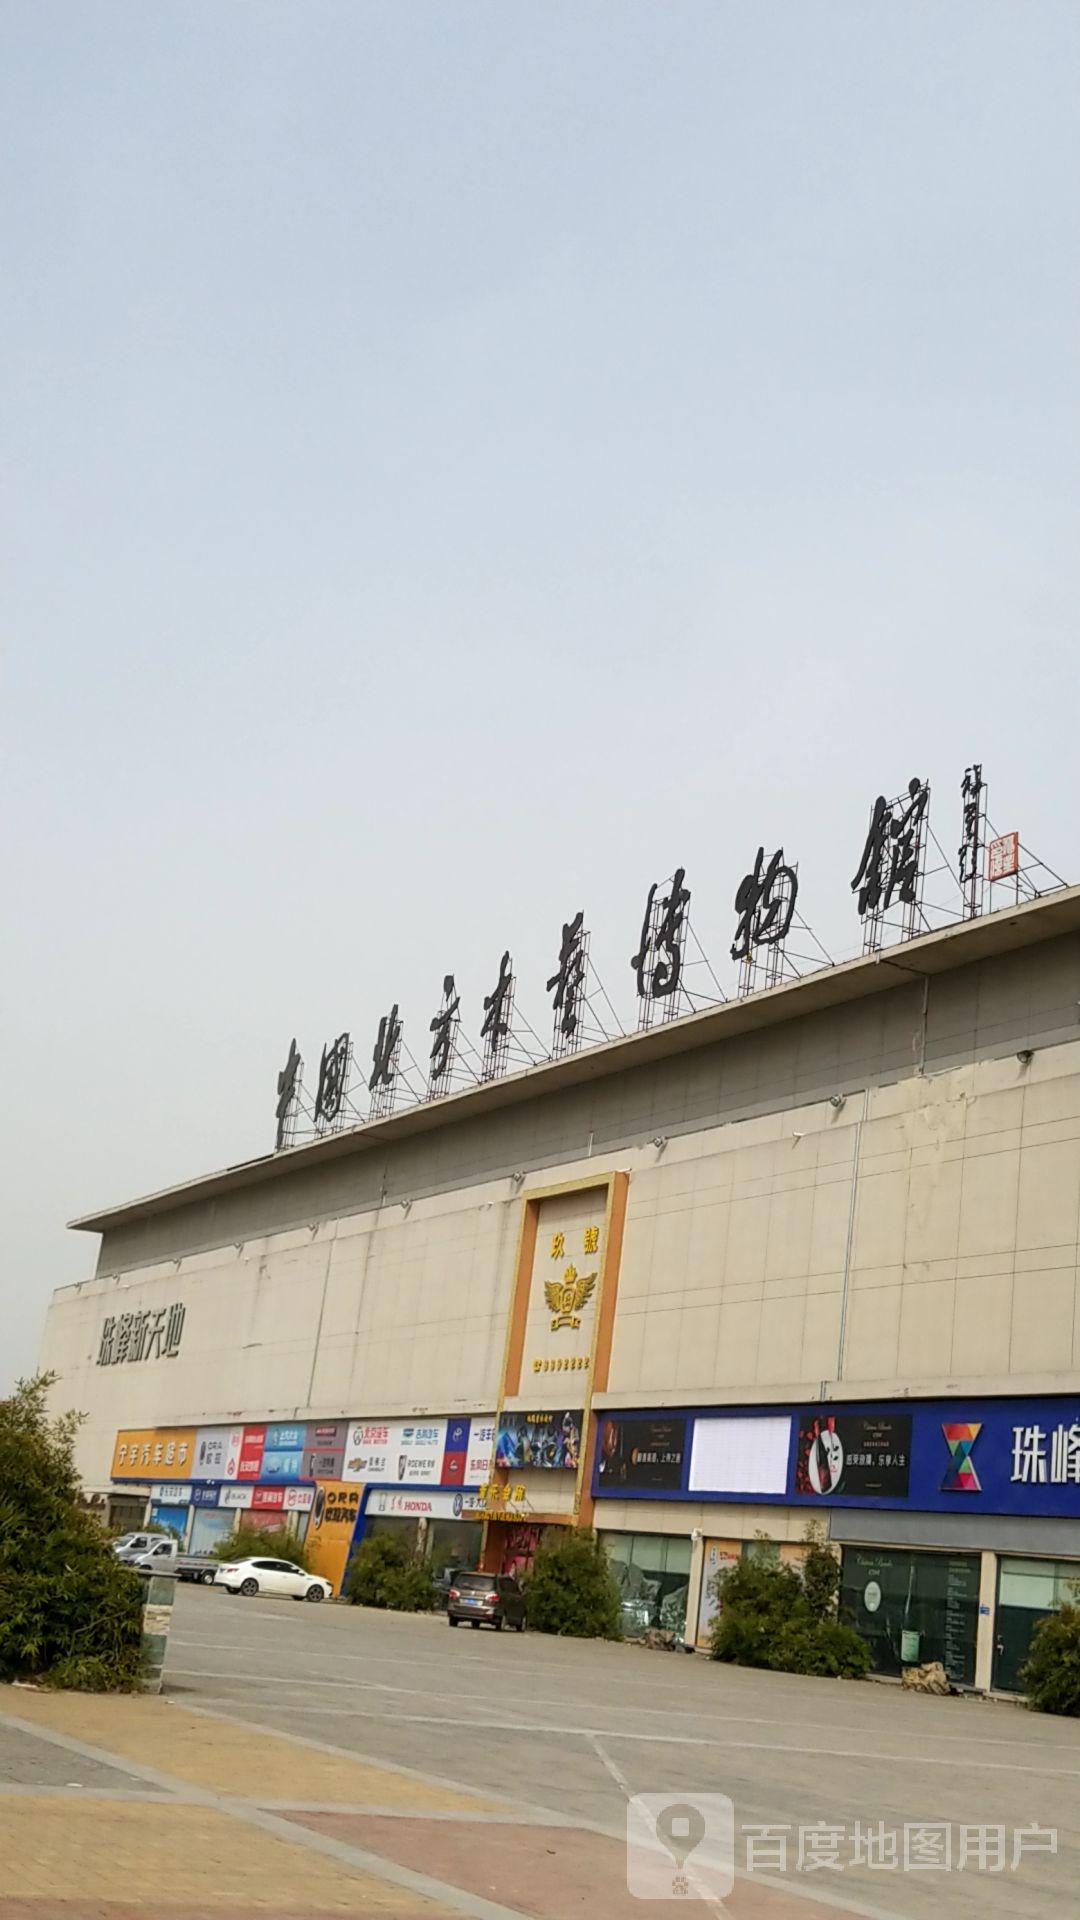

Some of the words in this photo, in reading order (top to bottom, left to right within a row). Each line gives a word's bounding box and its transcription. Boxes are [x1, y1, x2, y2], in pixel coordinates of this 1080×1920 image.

[327, 1492, 359, 1504] ORA
[404, 1501, 432, 1512] HONDA
[325, 1507, 357, 1522] 欧拉汽车
